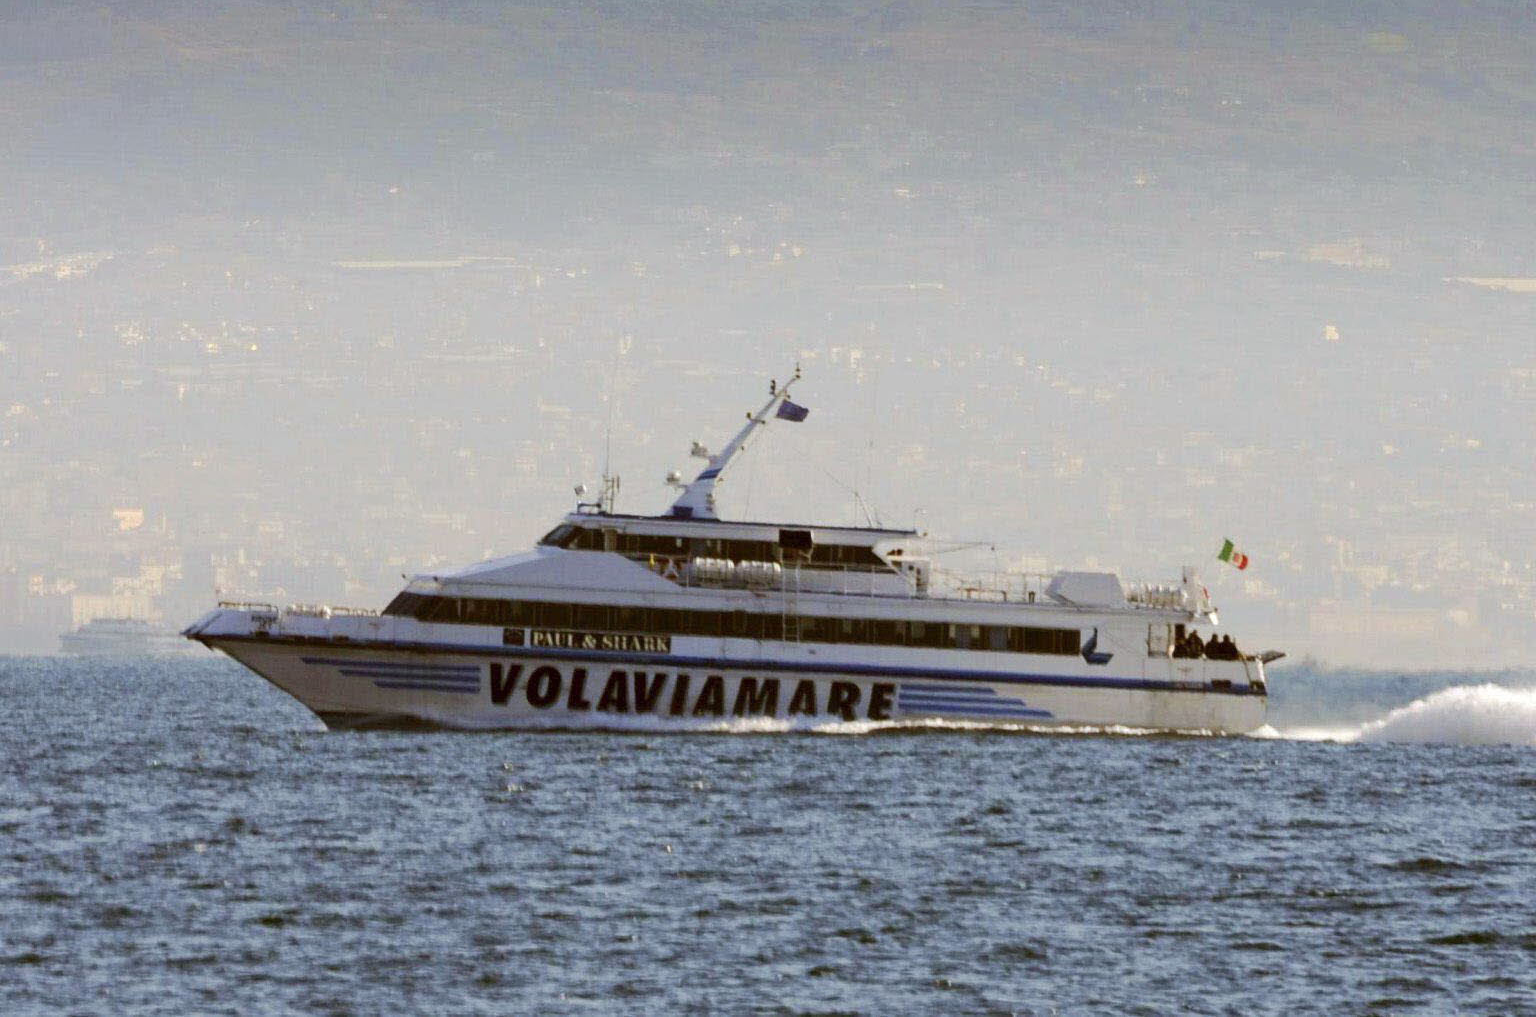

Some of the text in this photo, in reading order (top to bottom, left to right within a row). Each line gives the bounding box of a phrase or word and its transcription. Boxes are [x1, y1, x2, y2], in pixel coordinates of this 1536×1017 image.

[533, 631, 668, 652] PAUL & SHARK
[488, 662, 898, 721] VOLAVIAMARE
